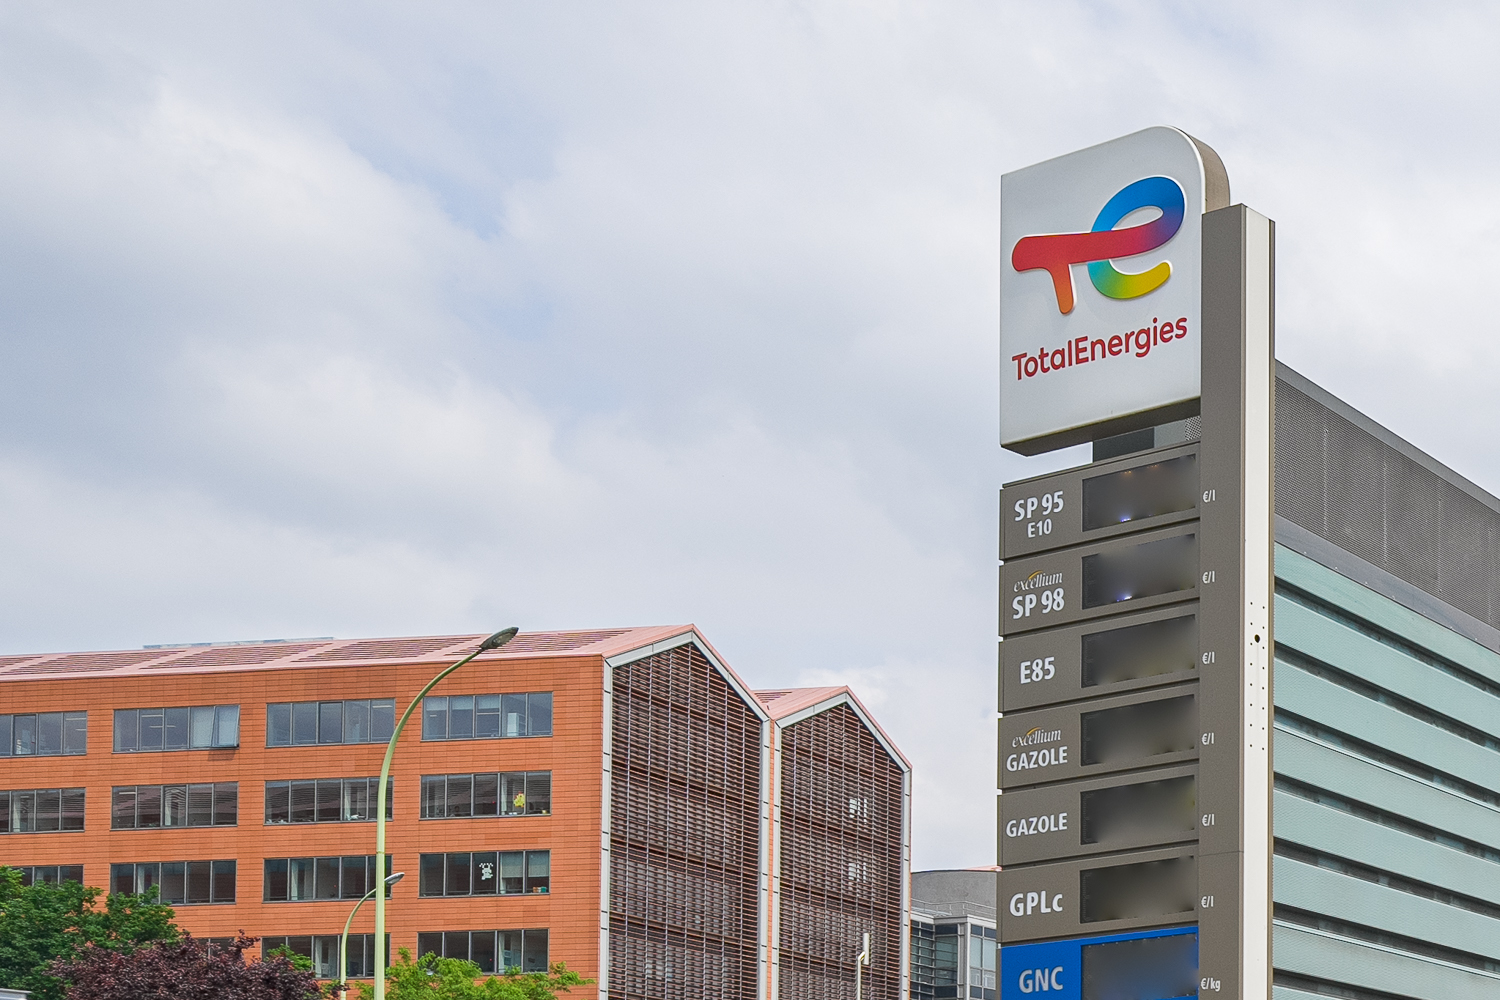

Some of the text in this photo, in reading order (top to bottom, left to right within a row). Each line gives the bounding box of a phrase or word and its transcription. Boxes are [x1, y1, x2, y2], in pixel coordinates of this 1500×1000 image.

[1012, 317, 1188, 381] TotalEnergies
[1014, 491, 1064, 522] SP 95
[1027, 518, 1052, 538] E10
[1013, 572, 1063, 592] excellium
[1012, 588, 1065, 619] SP 98
[1020, 657, 1055, 685] E85
[1012, 727, 1061, 748] excellium
[1006, 746, 1068, 772] GAZOLE
[1006, 812, 1068, 838] GAZOLE
[1010, 890, 1063, 917] GPLc
[1019, 966, 1063, 993] GNC
